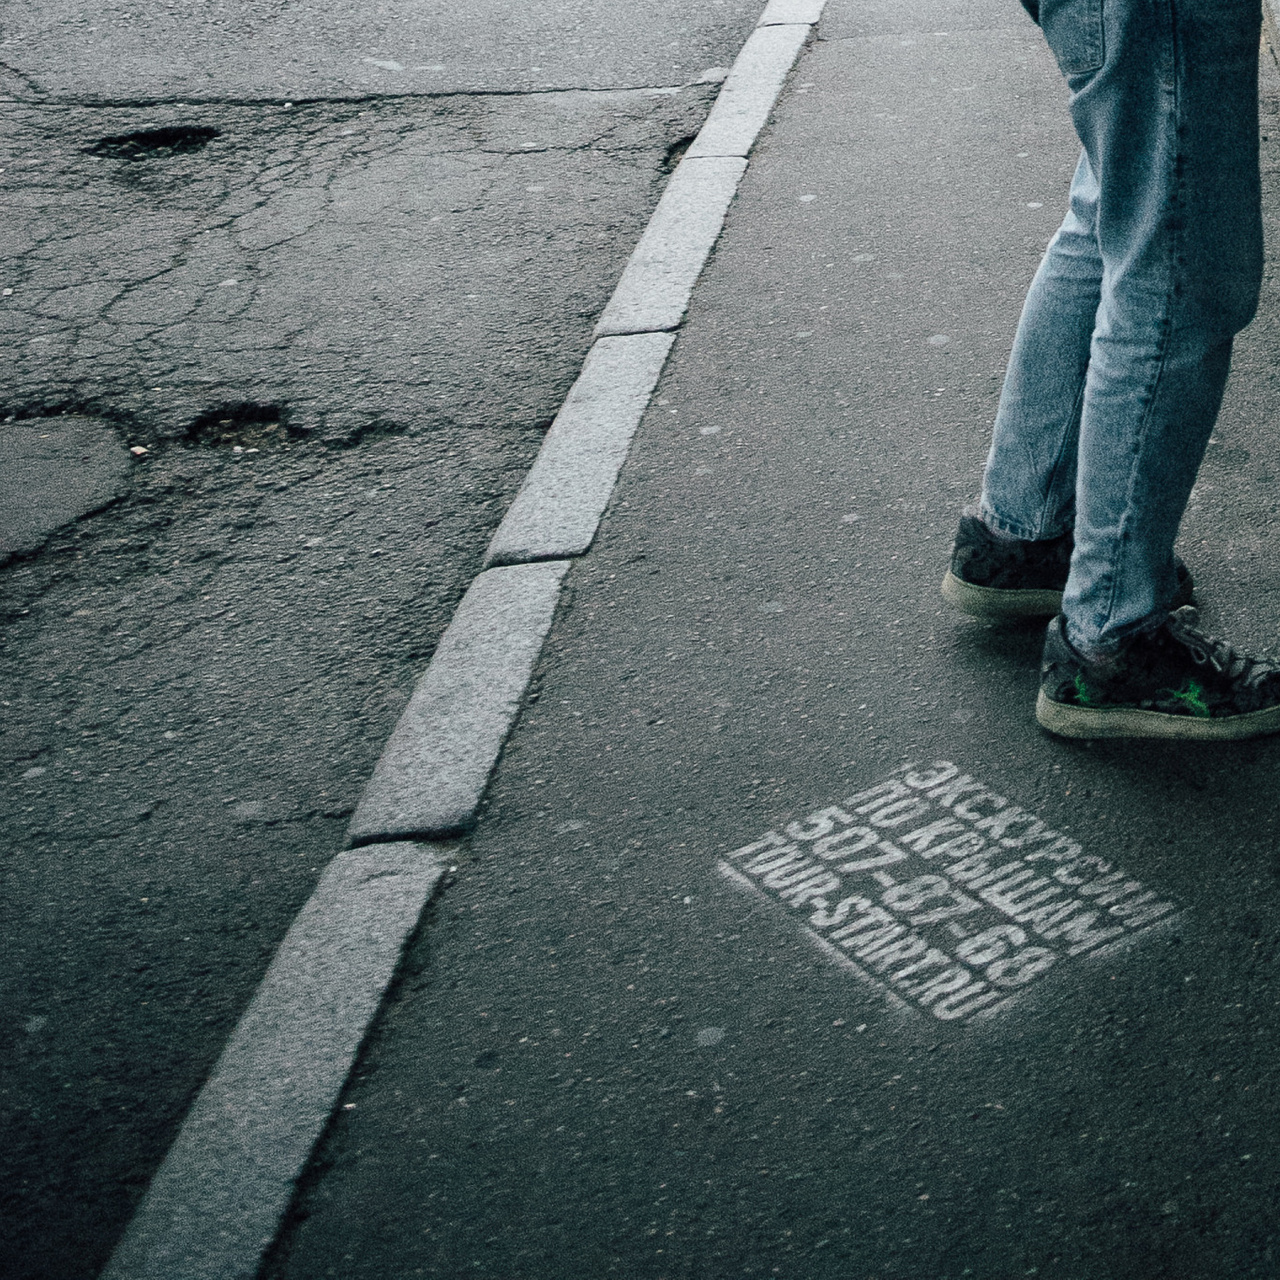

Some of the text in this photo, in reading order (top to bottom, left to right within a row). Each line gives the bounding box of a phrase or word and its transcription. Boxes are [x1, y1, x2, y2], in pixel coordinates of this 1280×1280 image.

[723, 831, 1000, 1021] TOUR-START.RU
[842, 778, 1124, 957] ПО КРЫШАМ
[904, 760, 1175, 927] ЭКСКУРСИИ
